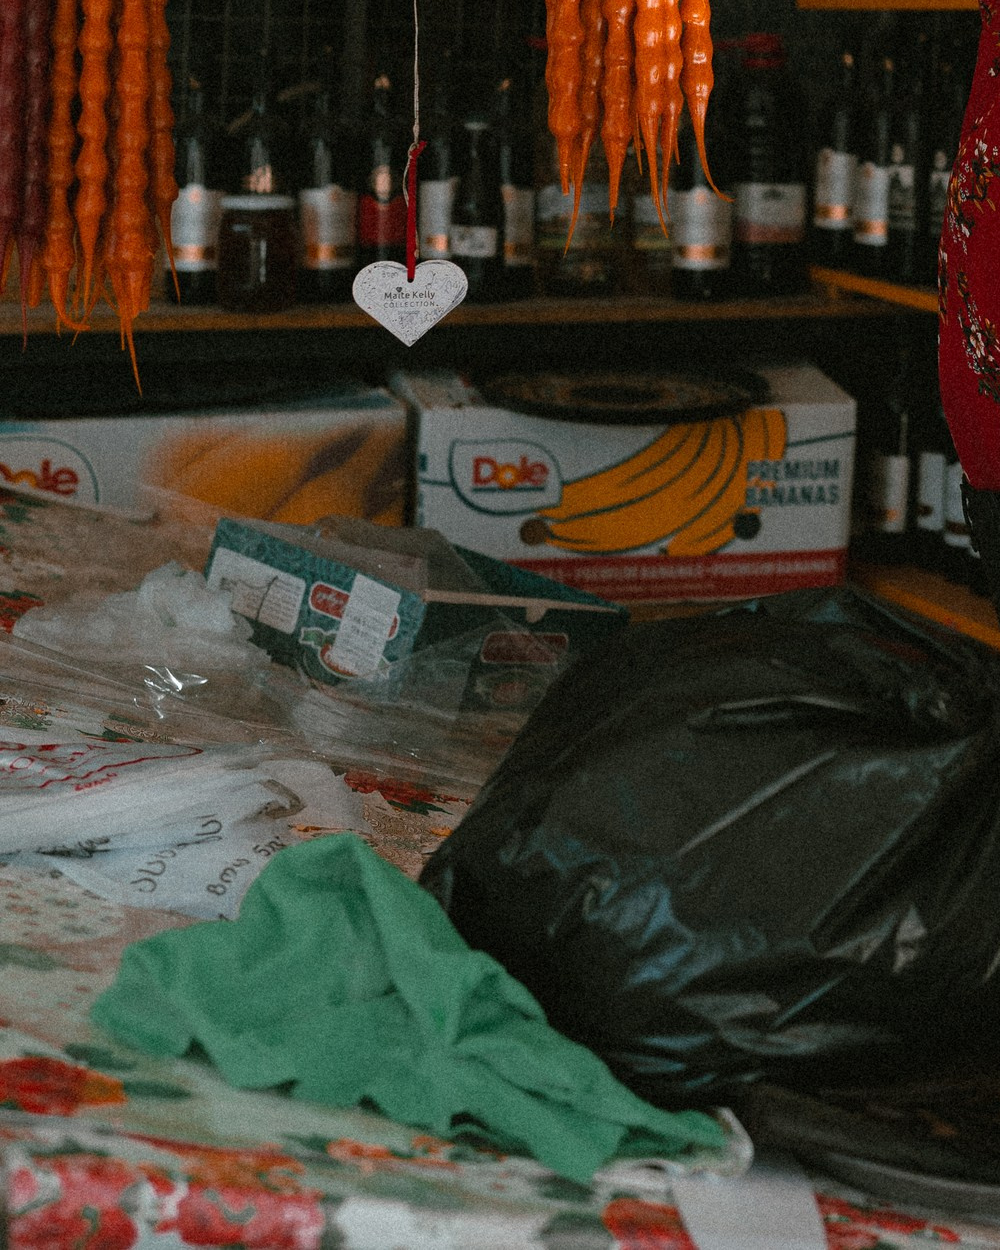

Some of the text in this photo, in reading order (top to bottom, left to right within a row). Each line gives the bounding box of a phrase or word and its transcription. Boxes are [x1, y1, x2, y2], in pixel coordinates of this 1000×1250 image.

[384, 301, 435, 309] COLLECTION
[412, 290, 435, 300] Kelly
[0, 458, 78, 496] ole
[472, 454, 548, 488] Dole
[748, 460, 839, 480] PREMIUM
[746, 485, 840, 507] BANANAS
